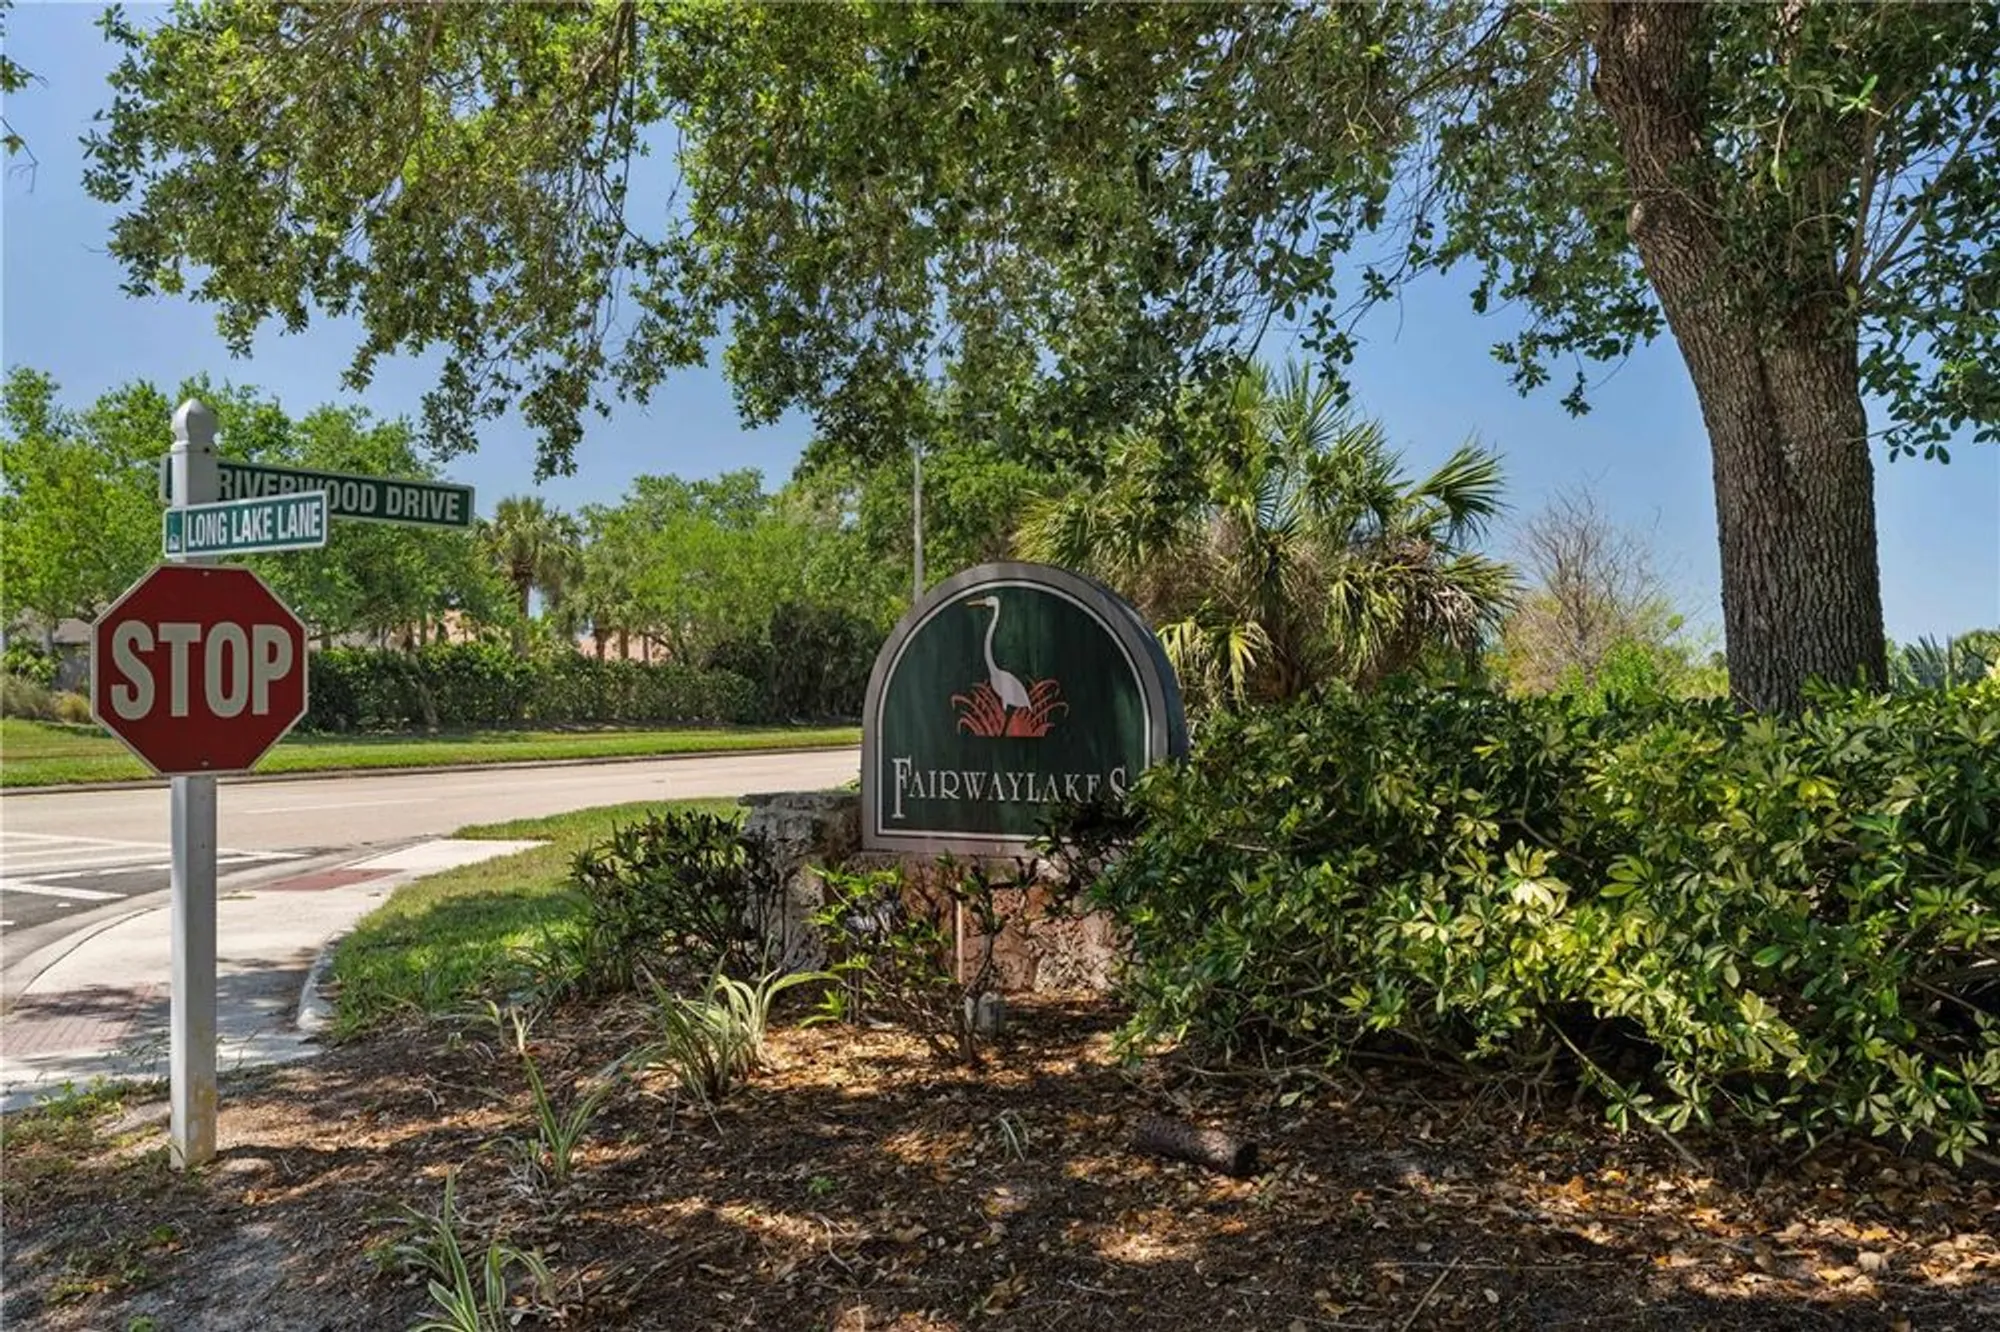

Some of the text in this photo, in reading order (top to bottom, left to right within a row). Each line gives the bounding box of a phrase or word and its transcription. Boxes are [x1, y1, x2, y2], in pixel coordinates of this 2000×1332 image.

[187, 502, 321, 547] LONG LAKE LANE
[386, 489, 461, 520] DRIVE
[111, 620, 293, 720] STOP
